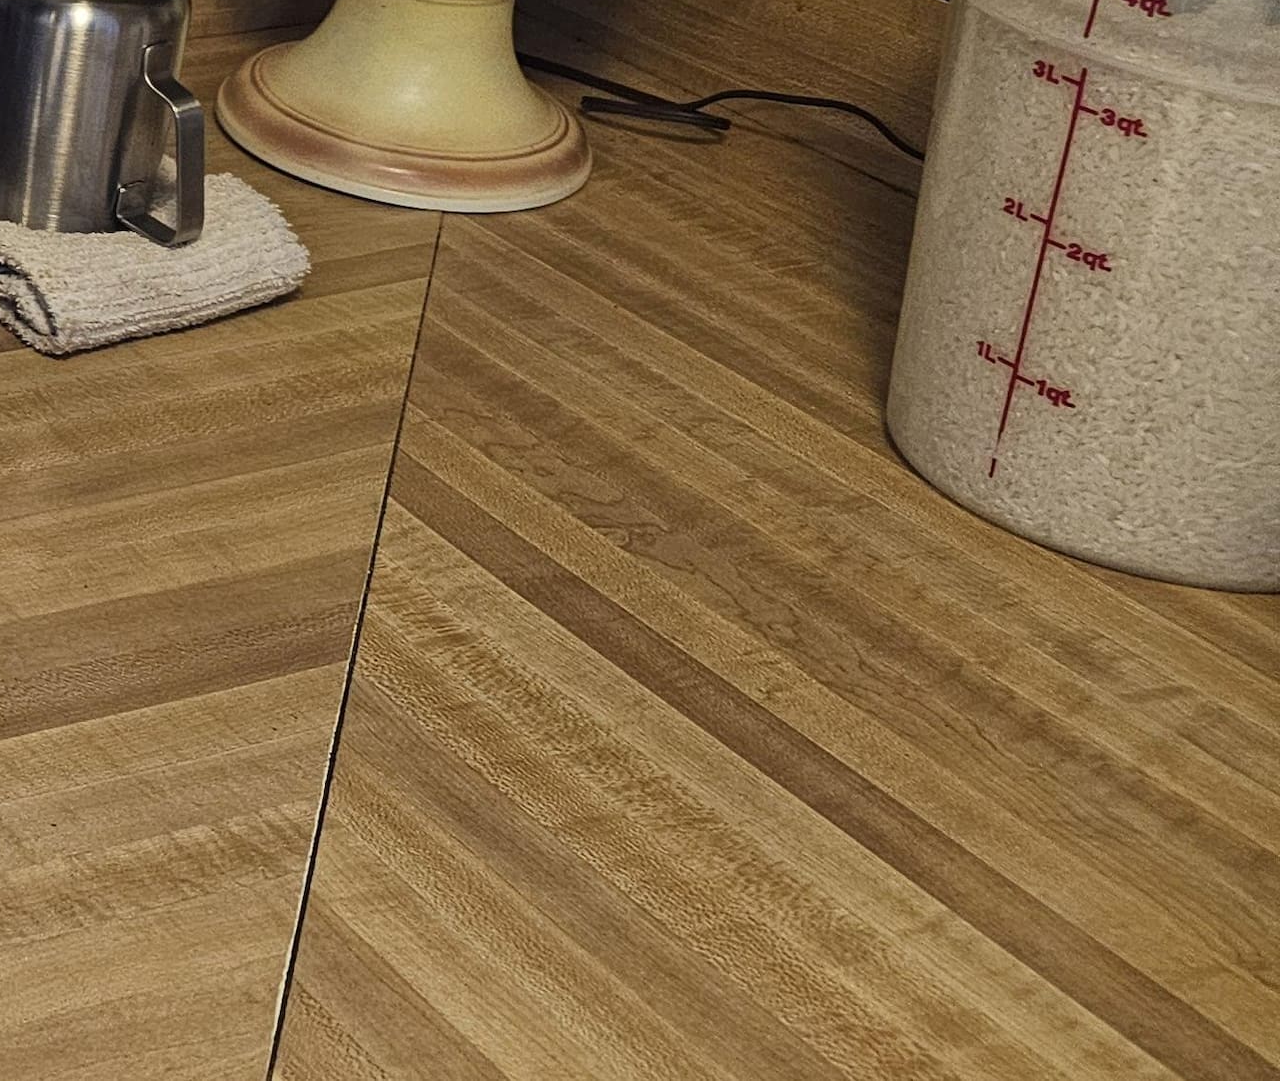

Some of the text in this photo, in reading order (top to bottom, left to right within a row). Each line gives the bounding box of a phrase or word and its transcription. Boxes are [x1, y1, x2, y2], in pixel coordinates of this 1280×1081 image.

[1032, 59, 1059, 85] 3L
[1002, 197, 1028, 222] 2L
[976, 340, 996, 364] 1L
